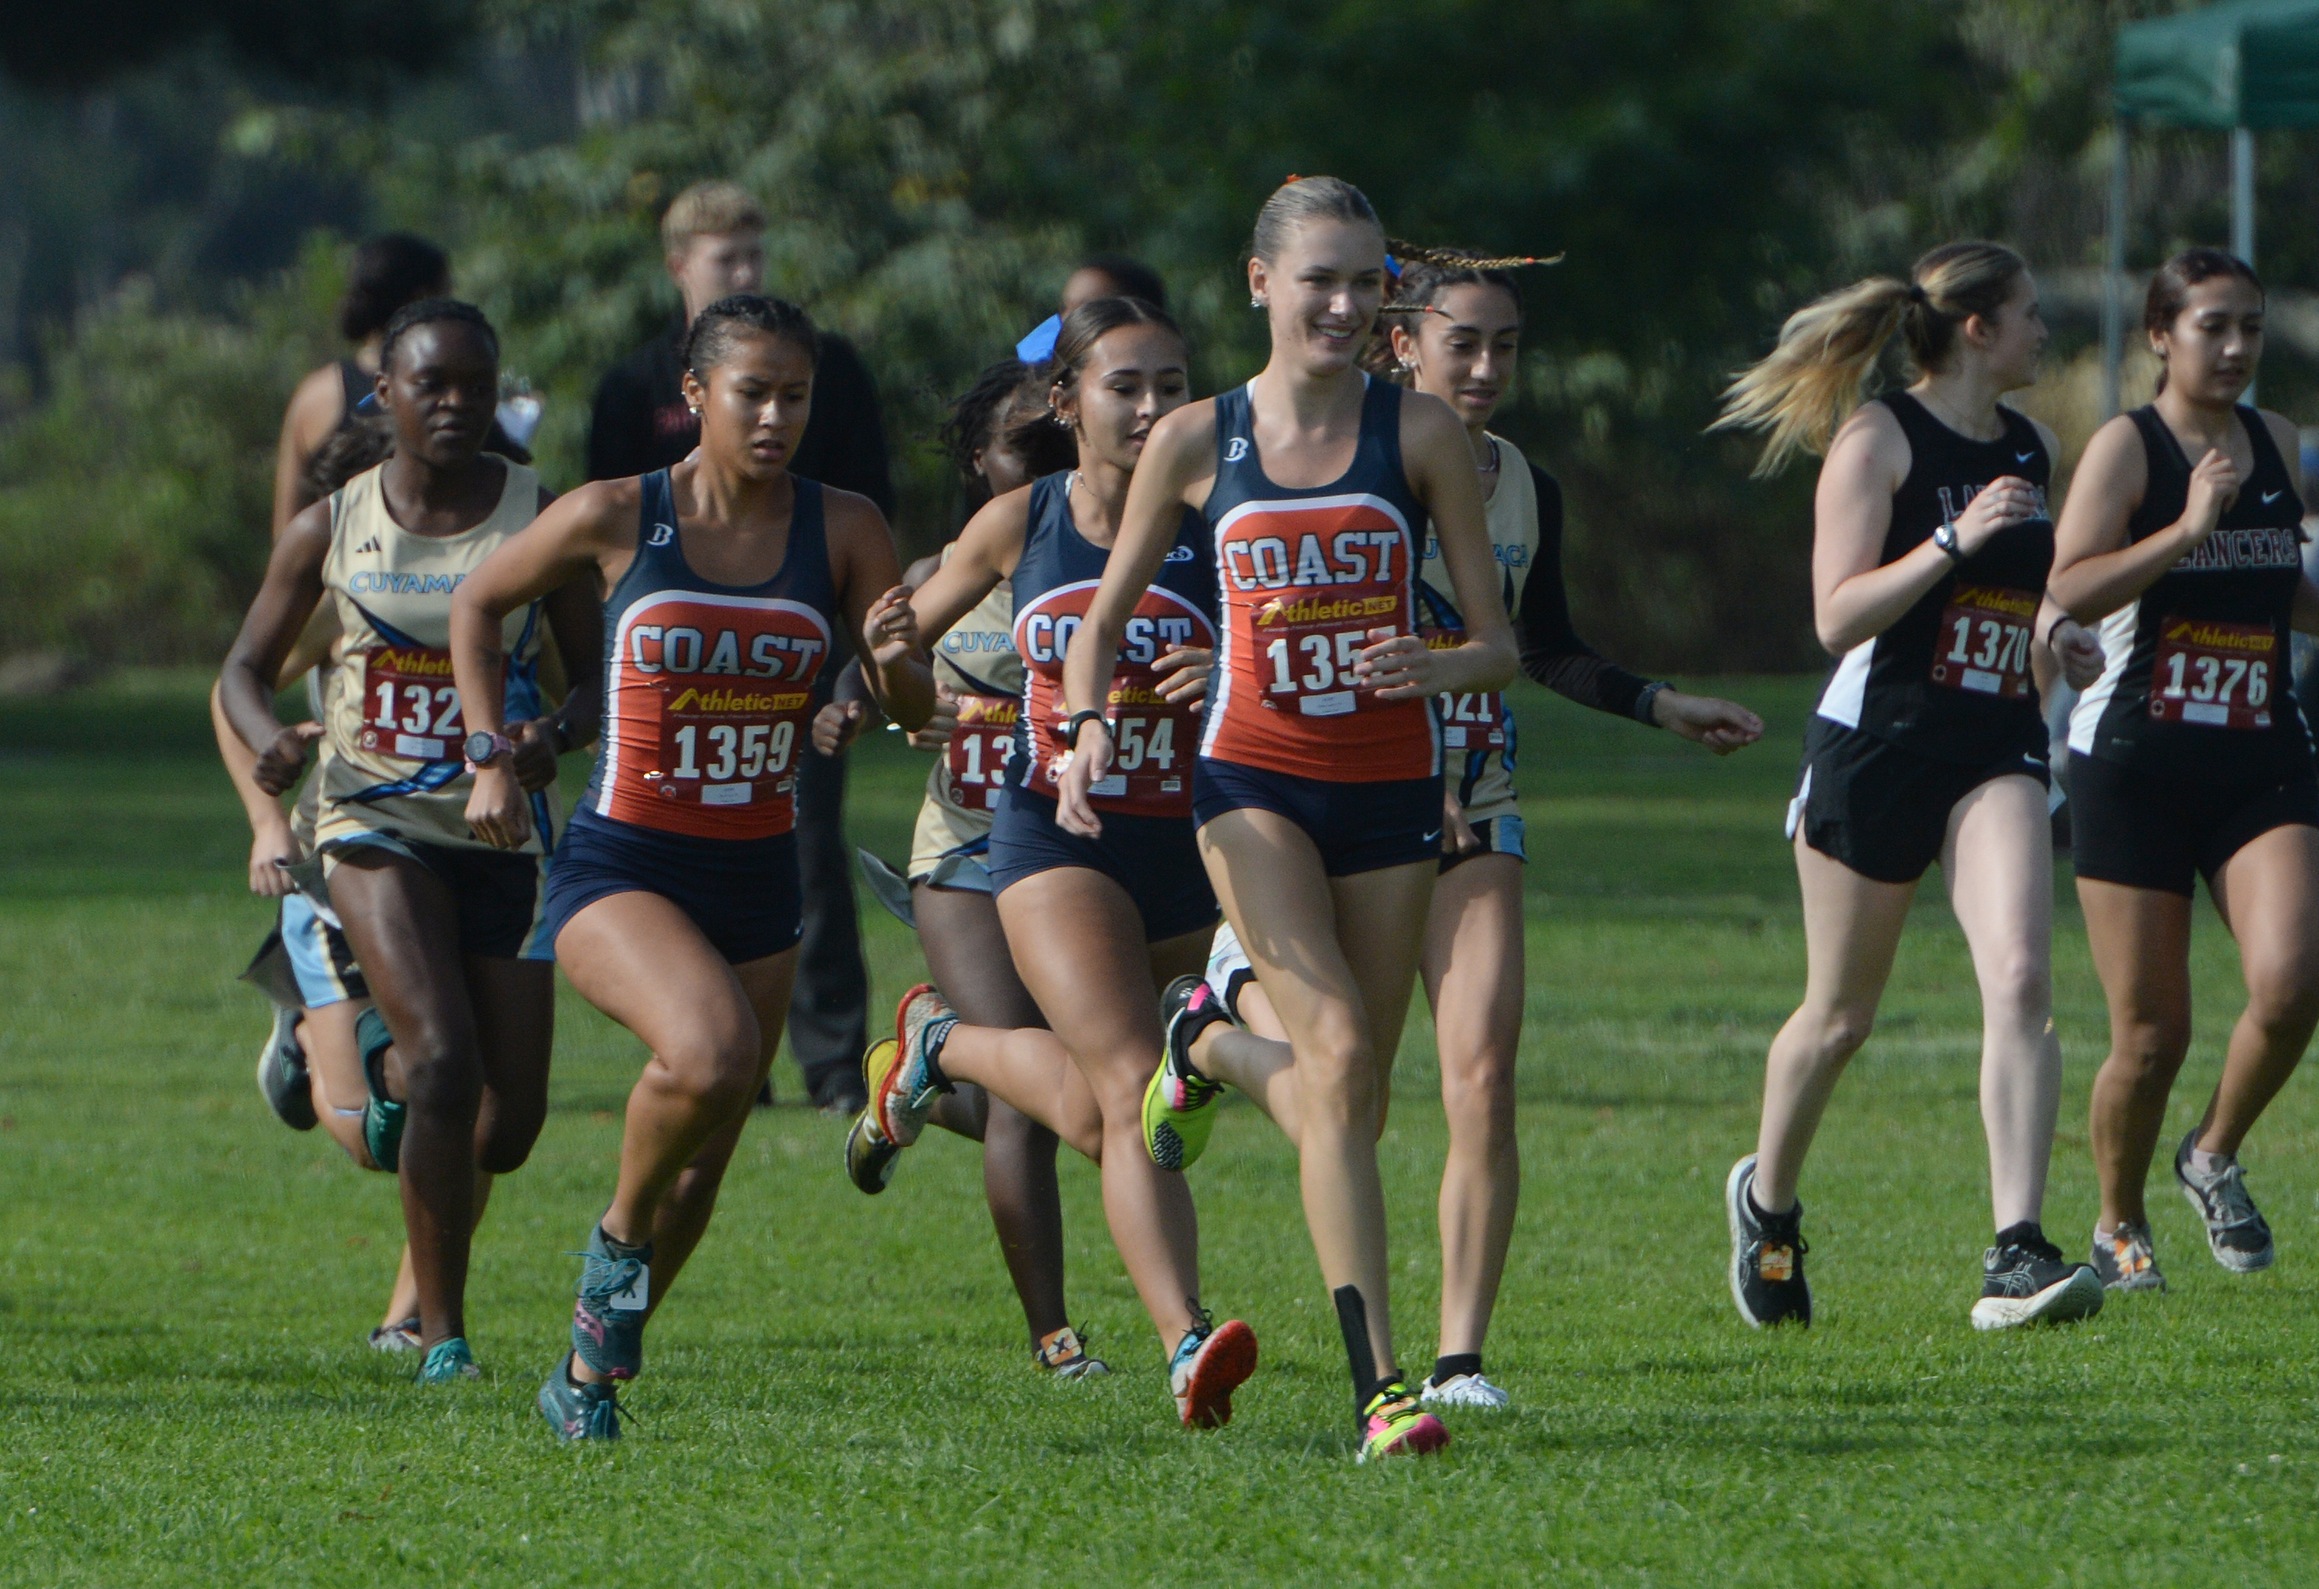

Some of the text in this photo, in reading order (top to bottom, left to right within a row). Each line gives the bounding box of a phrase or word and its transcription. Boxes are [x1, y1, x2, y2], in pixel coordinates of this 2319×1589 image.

[1222, 531, 1400, 591] COAST
[630, 624, 823, 683] COAST
[943, 631, 1016, 653] CUYA
[1026, 613, 1192, 664] COST
[1946, 616, 2030, 675] 1370
[2163, 652, 2268, 707] 1376
[673, 720, 796, 780] 1359
